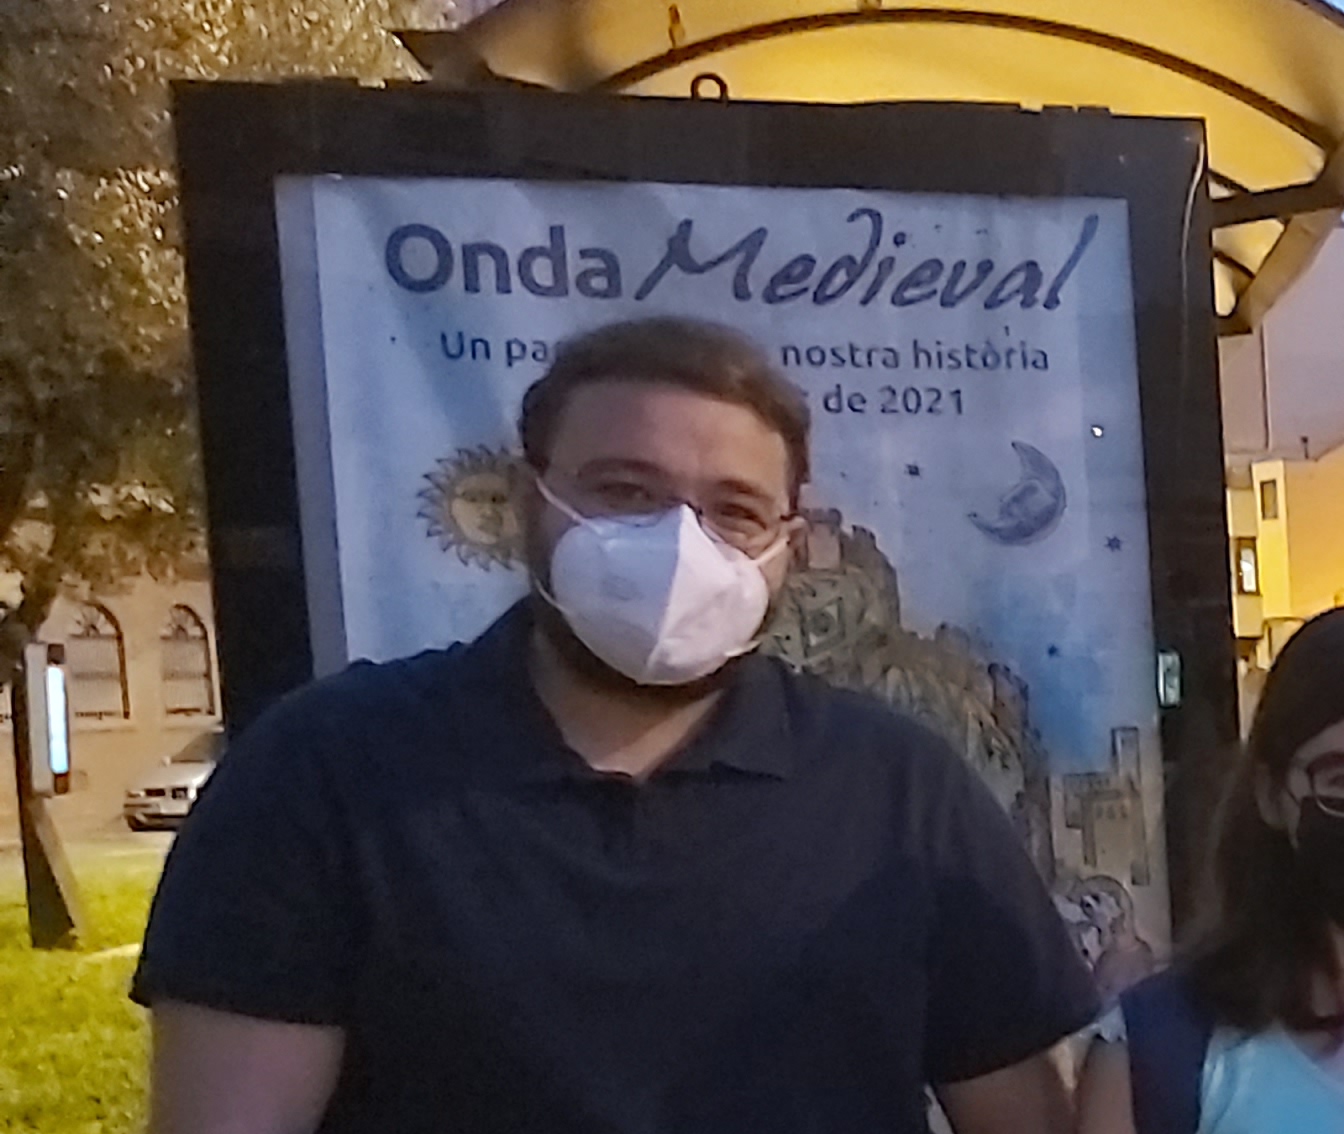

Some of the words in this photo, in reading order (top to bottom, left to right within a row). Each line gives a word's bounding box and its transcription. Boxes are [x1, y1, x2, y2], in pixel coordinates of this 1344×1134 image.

[385, 223, 623, 298] Onda
[634, 207, 1099, 309] Medieval
[440, 331, 491, 360] Un
[780, 341, 900, 369] nostra
[912, 338, 1049, 370] història
[823, 384, 867, 413] de
[879, 386, 963, 414] 2021
